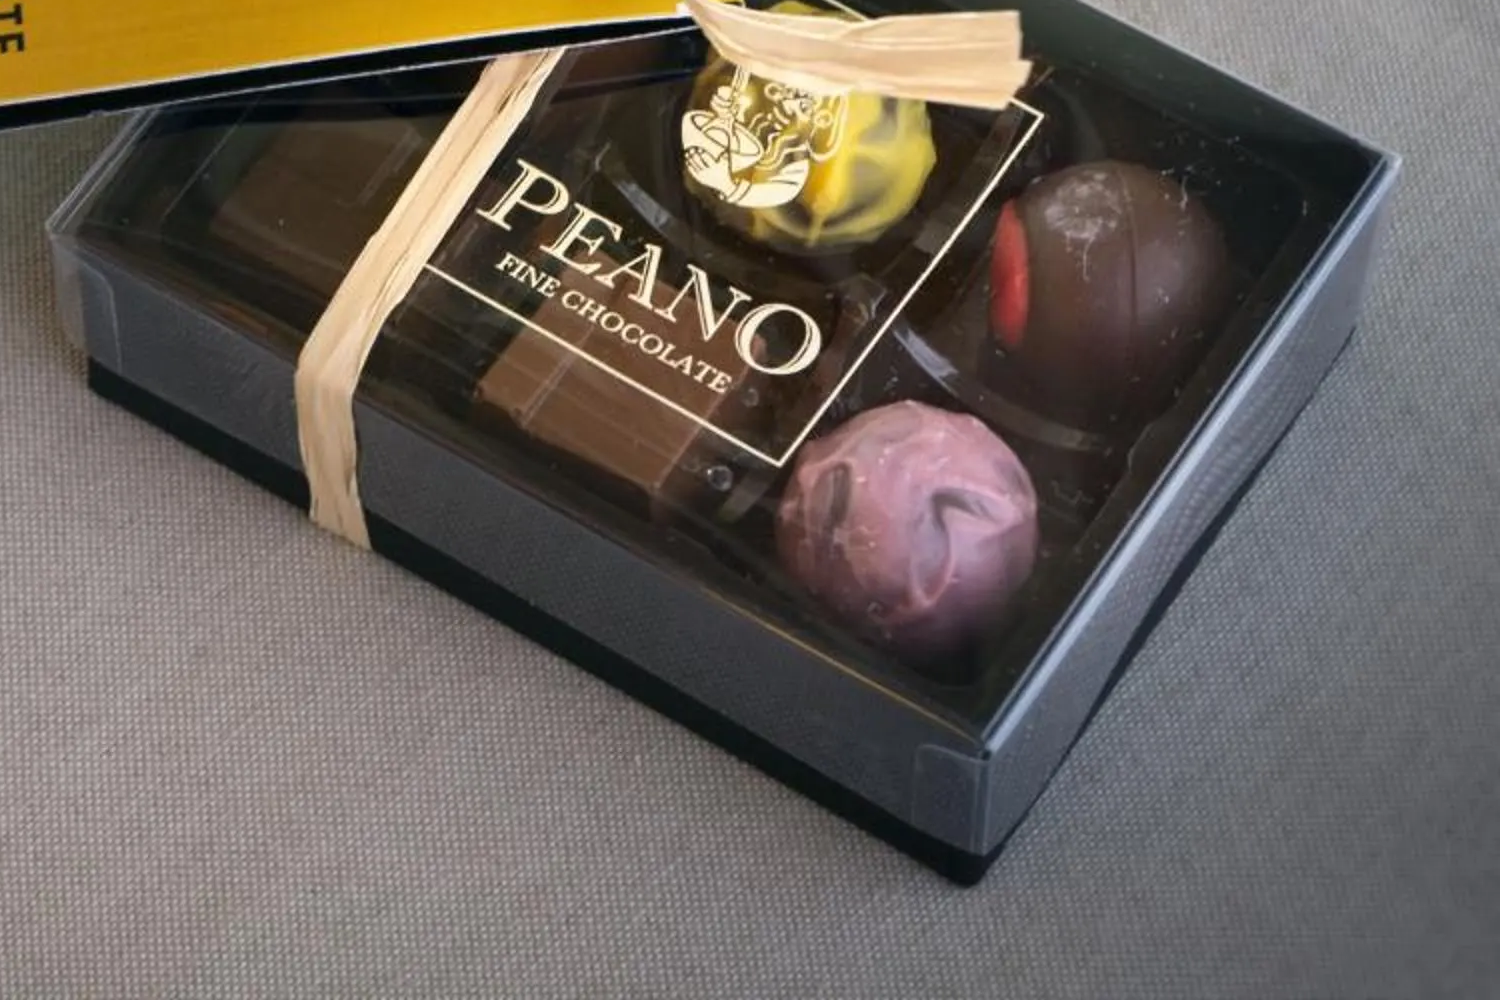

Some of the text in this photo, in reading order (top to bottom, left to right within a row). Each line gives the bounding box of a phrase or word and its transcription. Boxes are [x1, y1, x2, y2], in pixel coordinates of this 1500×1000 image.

[476, 158, 823, 376] PEANO
[495, 252, 734, 395] FINE CHOCOLATE
